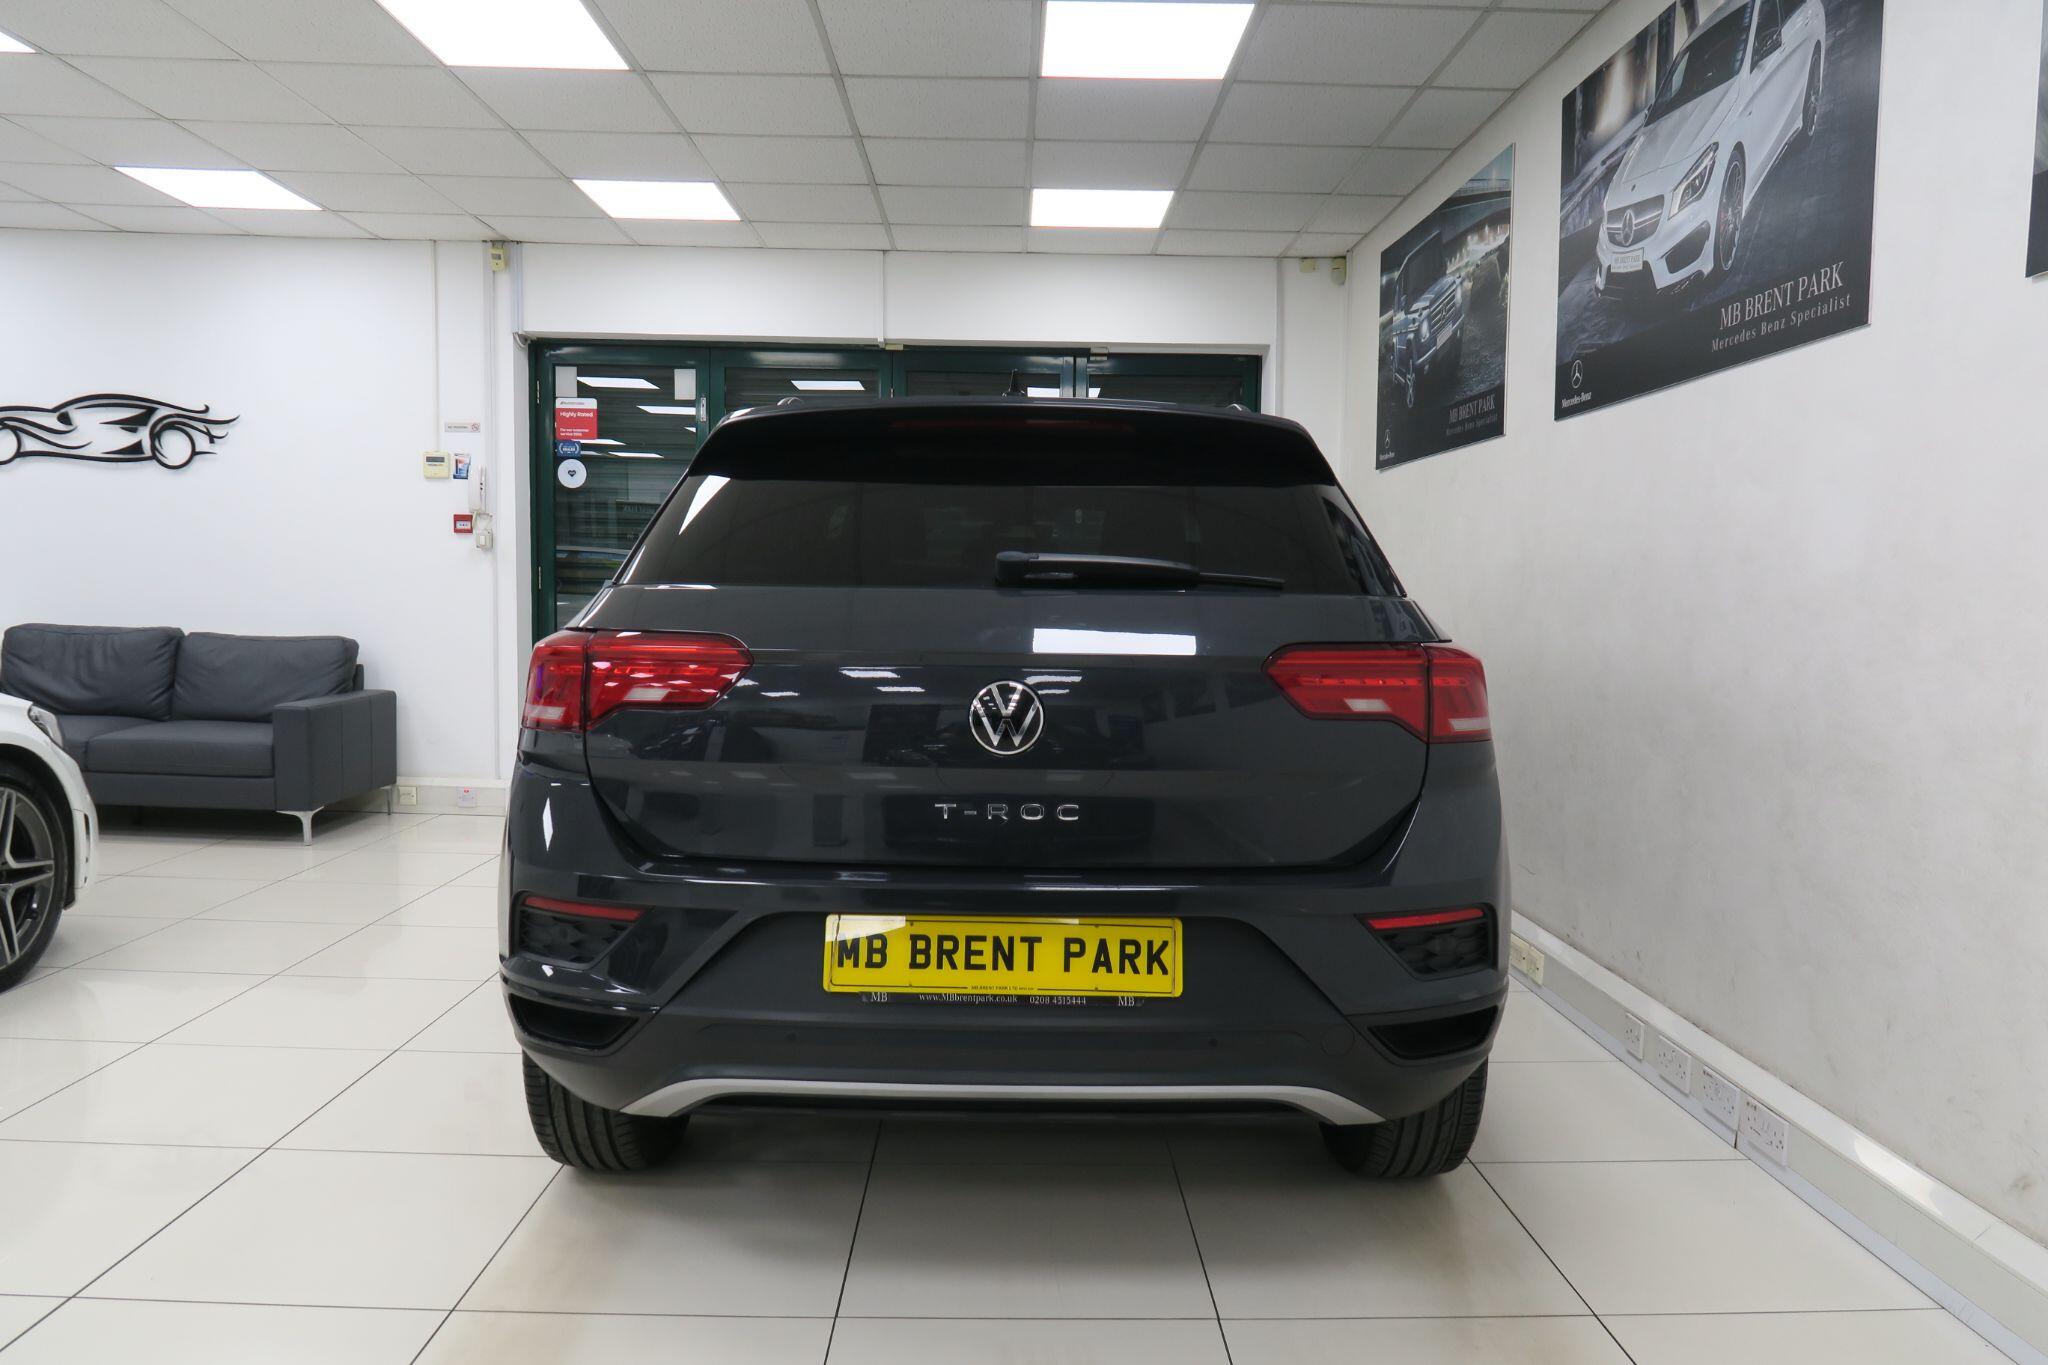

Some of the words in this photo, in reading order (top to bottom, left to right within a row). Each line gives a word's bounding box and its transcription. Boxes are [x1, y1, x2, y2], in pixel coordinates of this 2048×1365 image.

[1719, 302, 1741, 330] MB
[1745, 281, 1794, 321] BRENT
[1797, 261, 1844, 302] PARK
[1711, 327, 1756, 353] Mercedes
[1761, 317, 1785, 336] Benz
[1790, 293, 1851, 327] Specialist
[1458, 400, 1478, 421] BRENT
[1478, 394, 1496, 413] PARK
[935, 803, 1079, 821] T-ROC
[837, 934, 888, 969] MB
[909, 934, 1043, 972] BRENT
[1063, 937, 1170, 975] PARK
[870, 991, 888, 1002] MB
[919, 993, 1018, 1004] www.MBbrentpark.co.uk
[1029, 996, 1050, 1004] 0208
[1052, 996, 1087, 1005] 4515444
[1117, 995, 1135, 1007] MB
